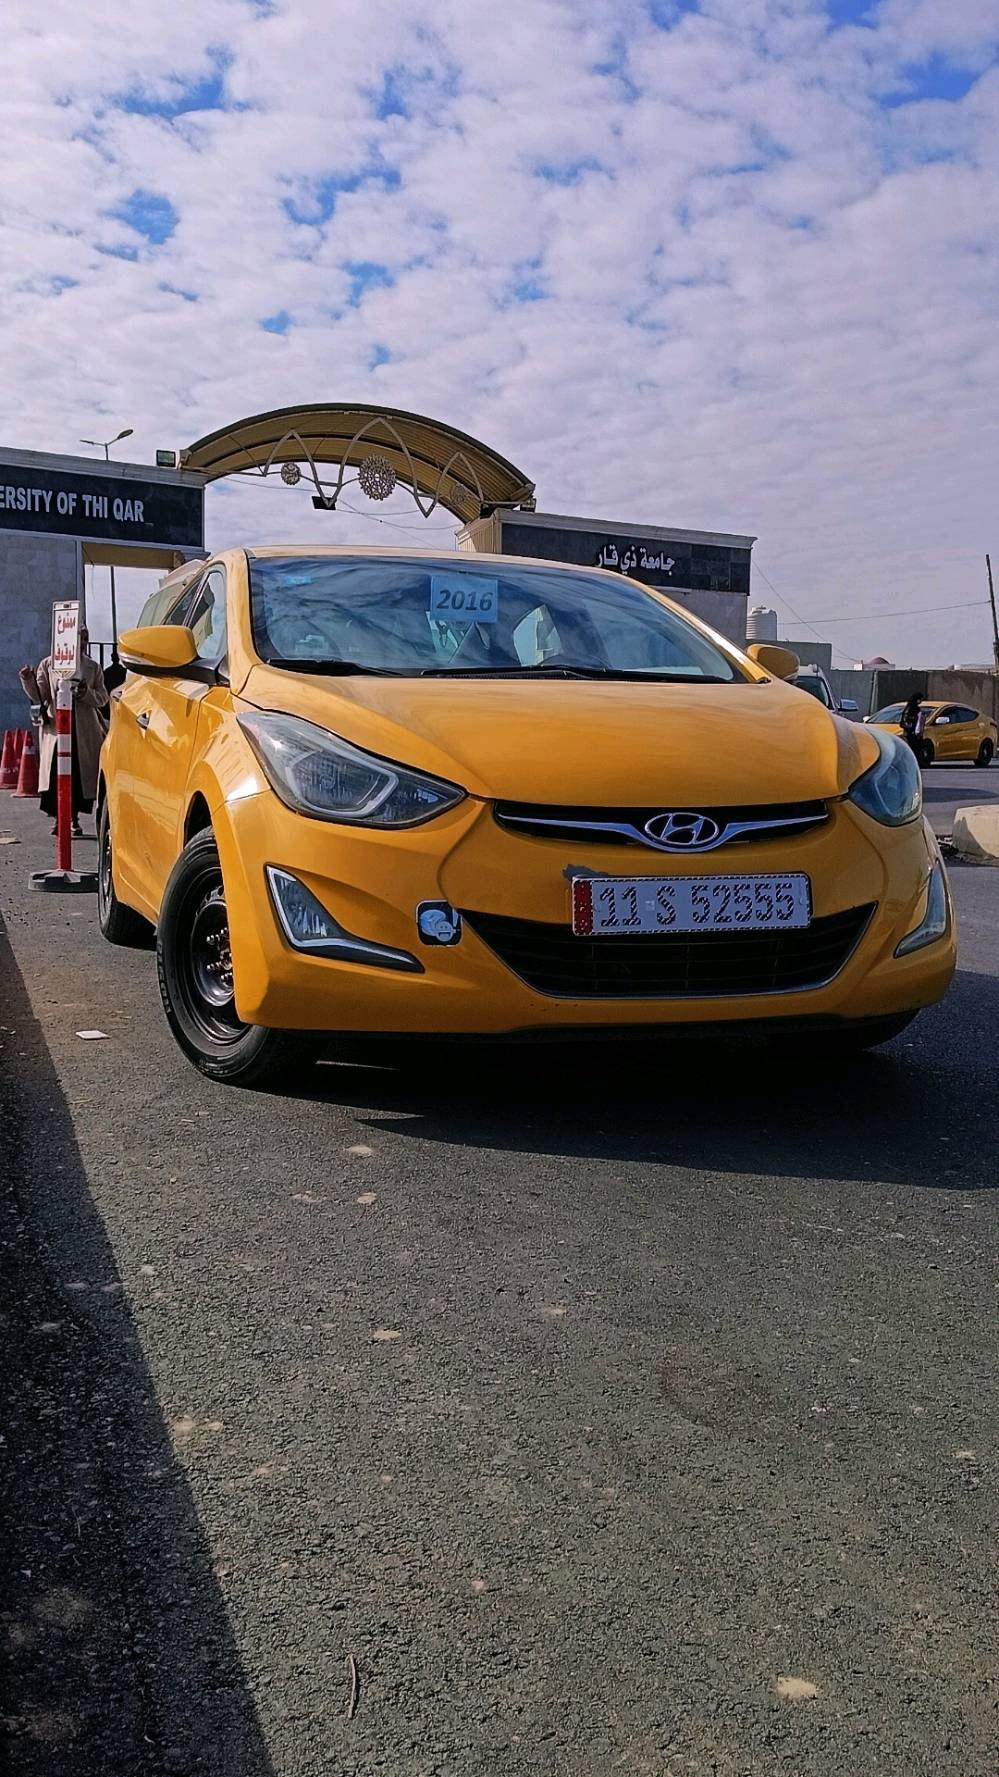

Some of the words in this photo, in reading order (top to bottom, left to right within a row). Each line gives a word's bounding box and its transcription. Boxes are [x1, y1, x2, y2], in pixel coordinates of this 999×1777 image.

[56, 491, 77, 515] OF
[82, 494, 108, 518] THI
[113, 498, 144, 522] QAR
[595, 544, 618, 567] قار
[620, 545, 637, 575] ذي
[640, 547, 675, 576] جامعة
[436, 589, 494, 611] 2016
[600, 886, 641, 927] 11
[655, 885, 677, 925] S
[691, 882, 794, 923] 52555
